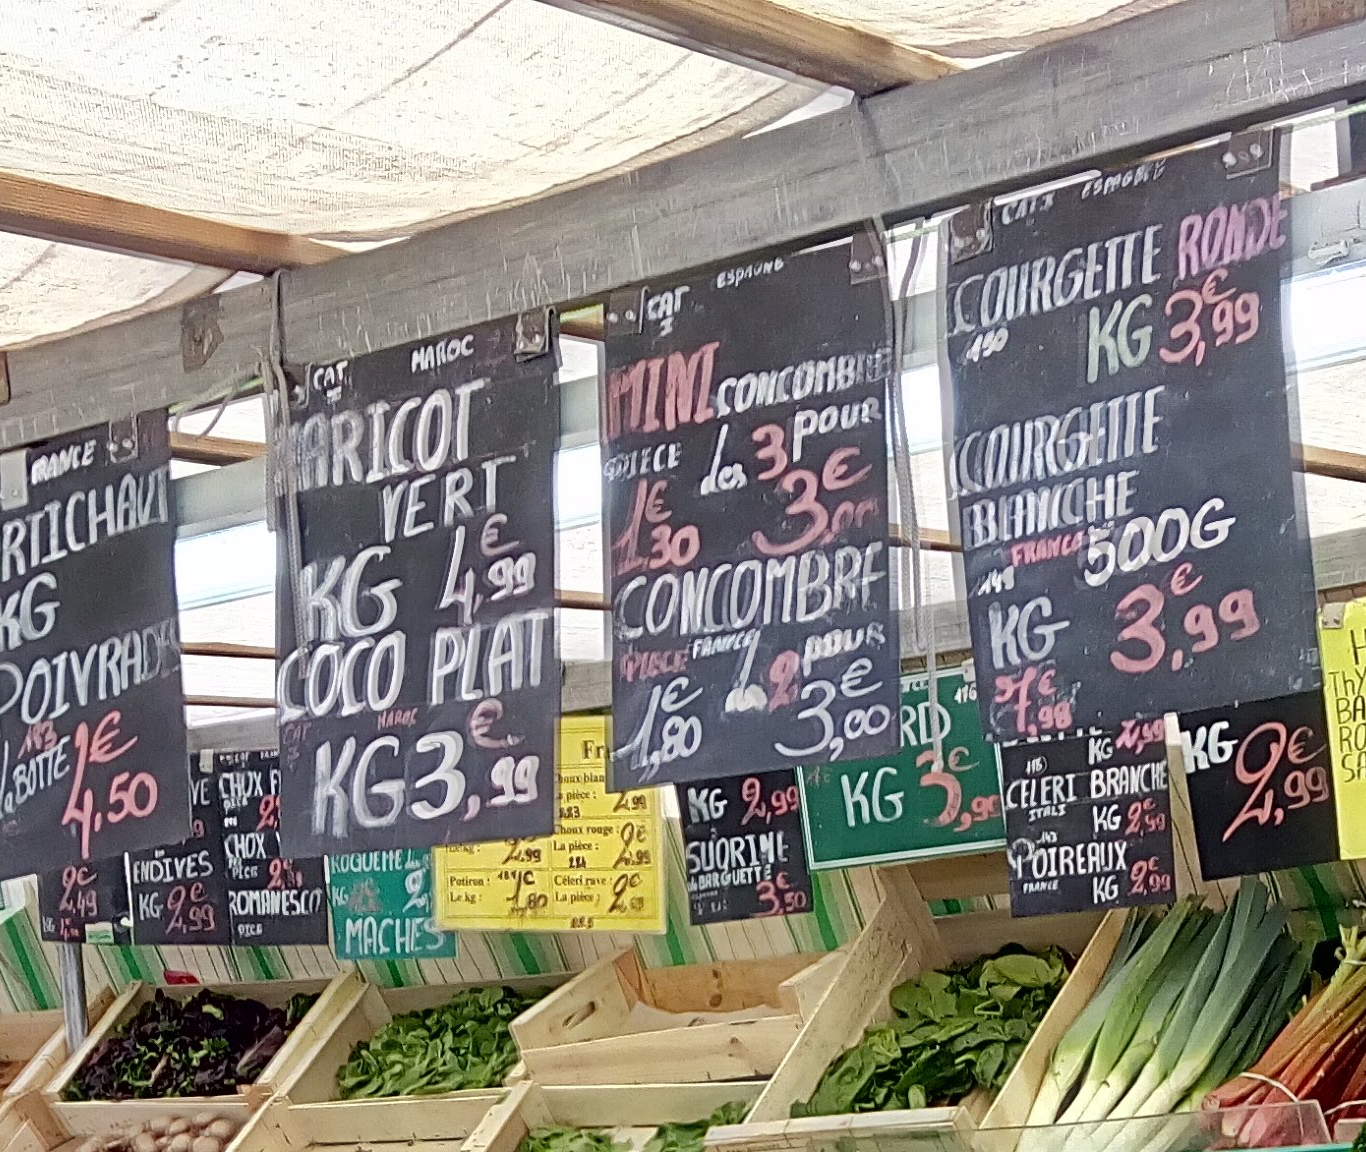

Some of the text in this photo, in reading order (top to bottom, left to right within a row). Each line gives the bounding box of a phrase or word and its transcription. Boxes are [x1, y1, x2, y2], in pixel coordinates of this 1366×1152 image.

[950, 194, 1289, 338] COURGETTE RONDE
[410, 333, 475, 374] MAROC
[1085, 293, 1155, 386] KG
[947, 384, 1167, 501] COURGETTE
[381, 454, 517, 544] VERT
[963, 470, 1238, 589] BLANCHE 500G
[298, 545, 403, 643] KG
[612, 540, 888, 640] CONCOMBRE
[277, 609, 550, 725] COCO PLAT
[987, 595, 1071, 671] KG
[12, 734, 72, 806] BOTTE
[1004, 759, 1169, 811] CELERI BRANCHE
[1087, 735, 1114, 766] KG
[1180, 719, 1239, 774] KG
[1221, 721, 1330, 844] 2,99
[311, 734, 407, 840] KG
[686, 786, 728, 825] KG
[839, 765, 905, 828] KG
[1092, 803, 1123, 837] KG
[133, 850, 214, 885] ENDIVES
[1007, 837, 1128, 880] POIREAUX
[1092, 875, 1120, 905] KG
[138, 892, 164, 922] KG
[345, 916, 445, 956] MACHES
